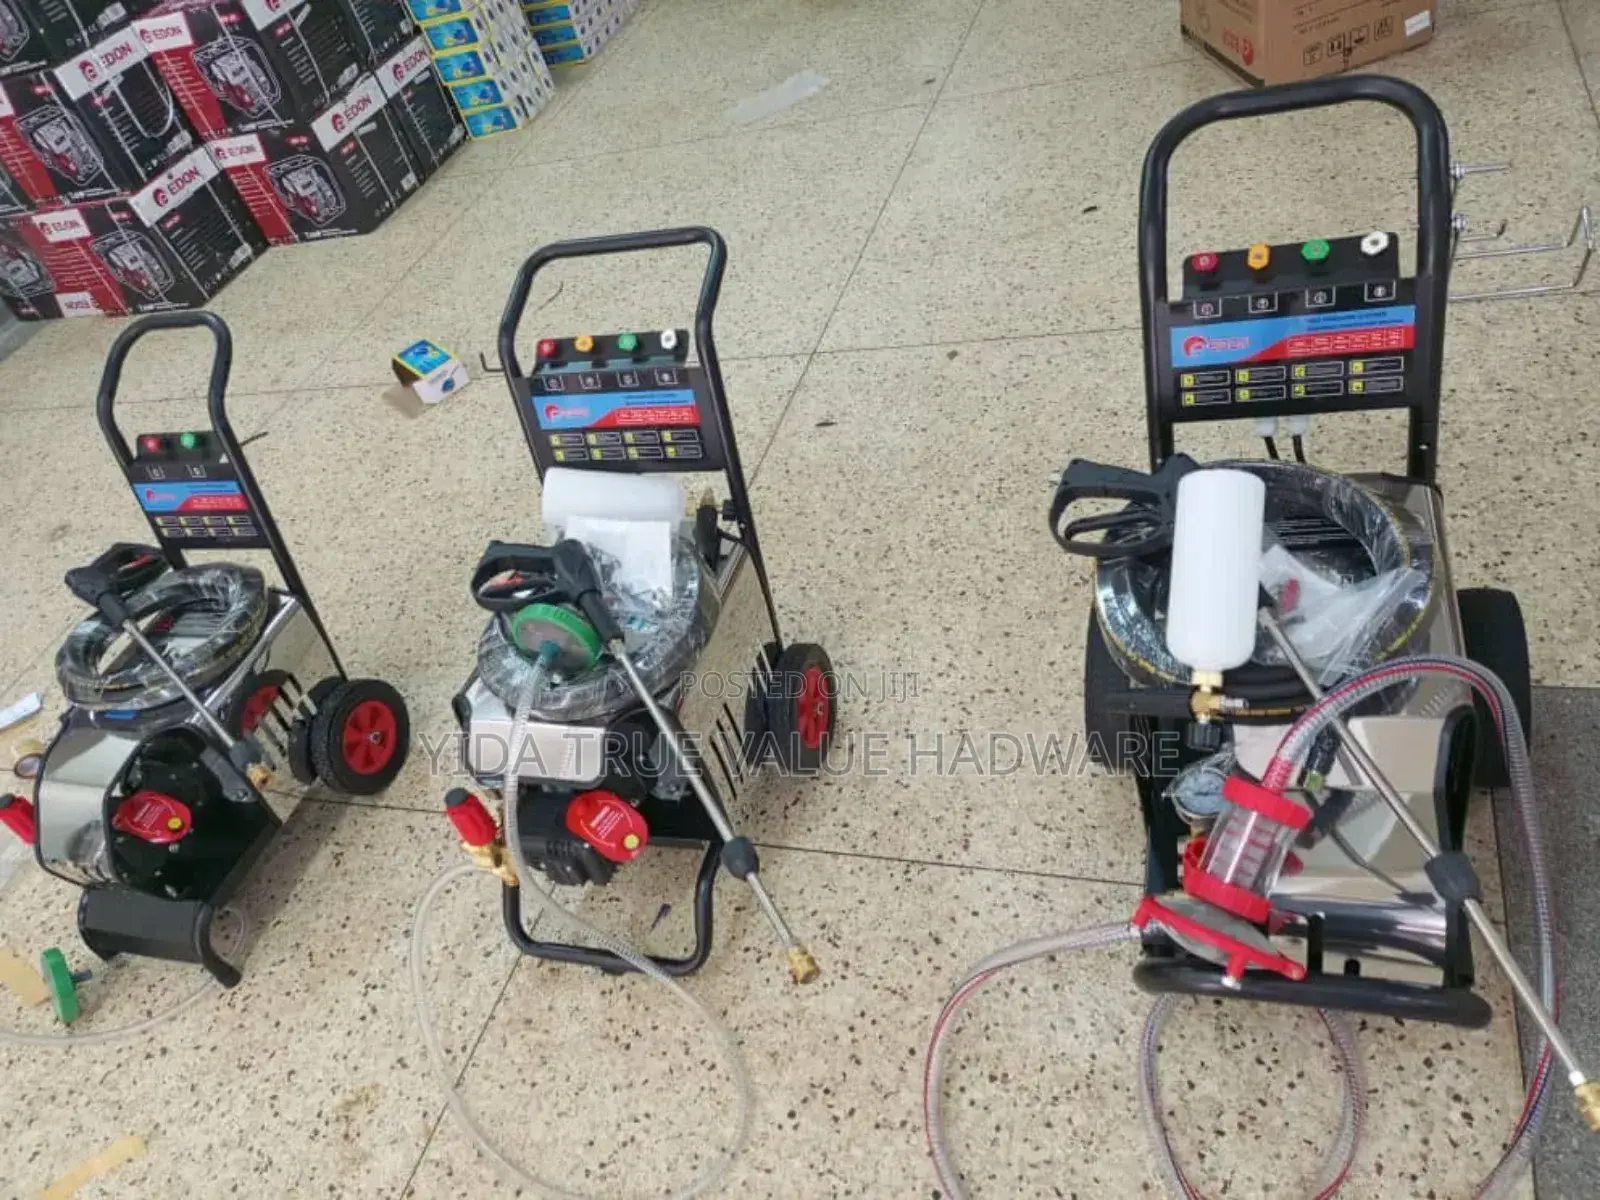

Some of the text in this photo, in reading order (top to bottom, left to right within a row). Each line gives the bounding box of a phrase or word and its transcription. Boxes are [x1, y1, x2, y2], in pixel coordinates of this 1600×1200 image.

[152, 26, 182, 40] EDON
[402, 49, 428, 69] EDON
[344, 94, 373, 121] EDON
[168, 166, 200, 195] EDON
